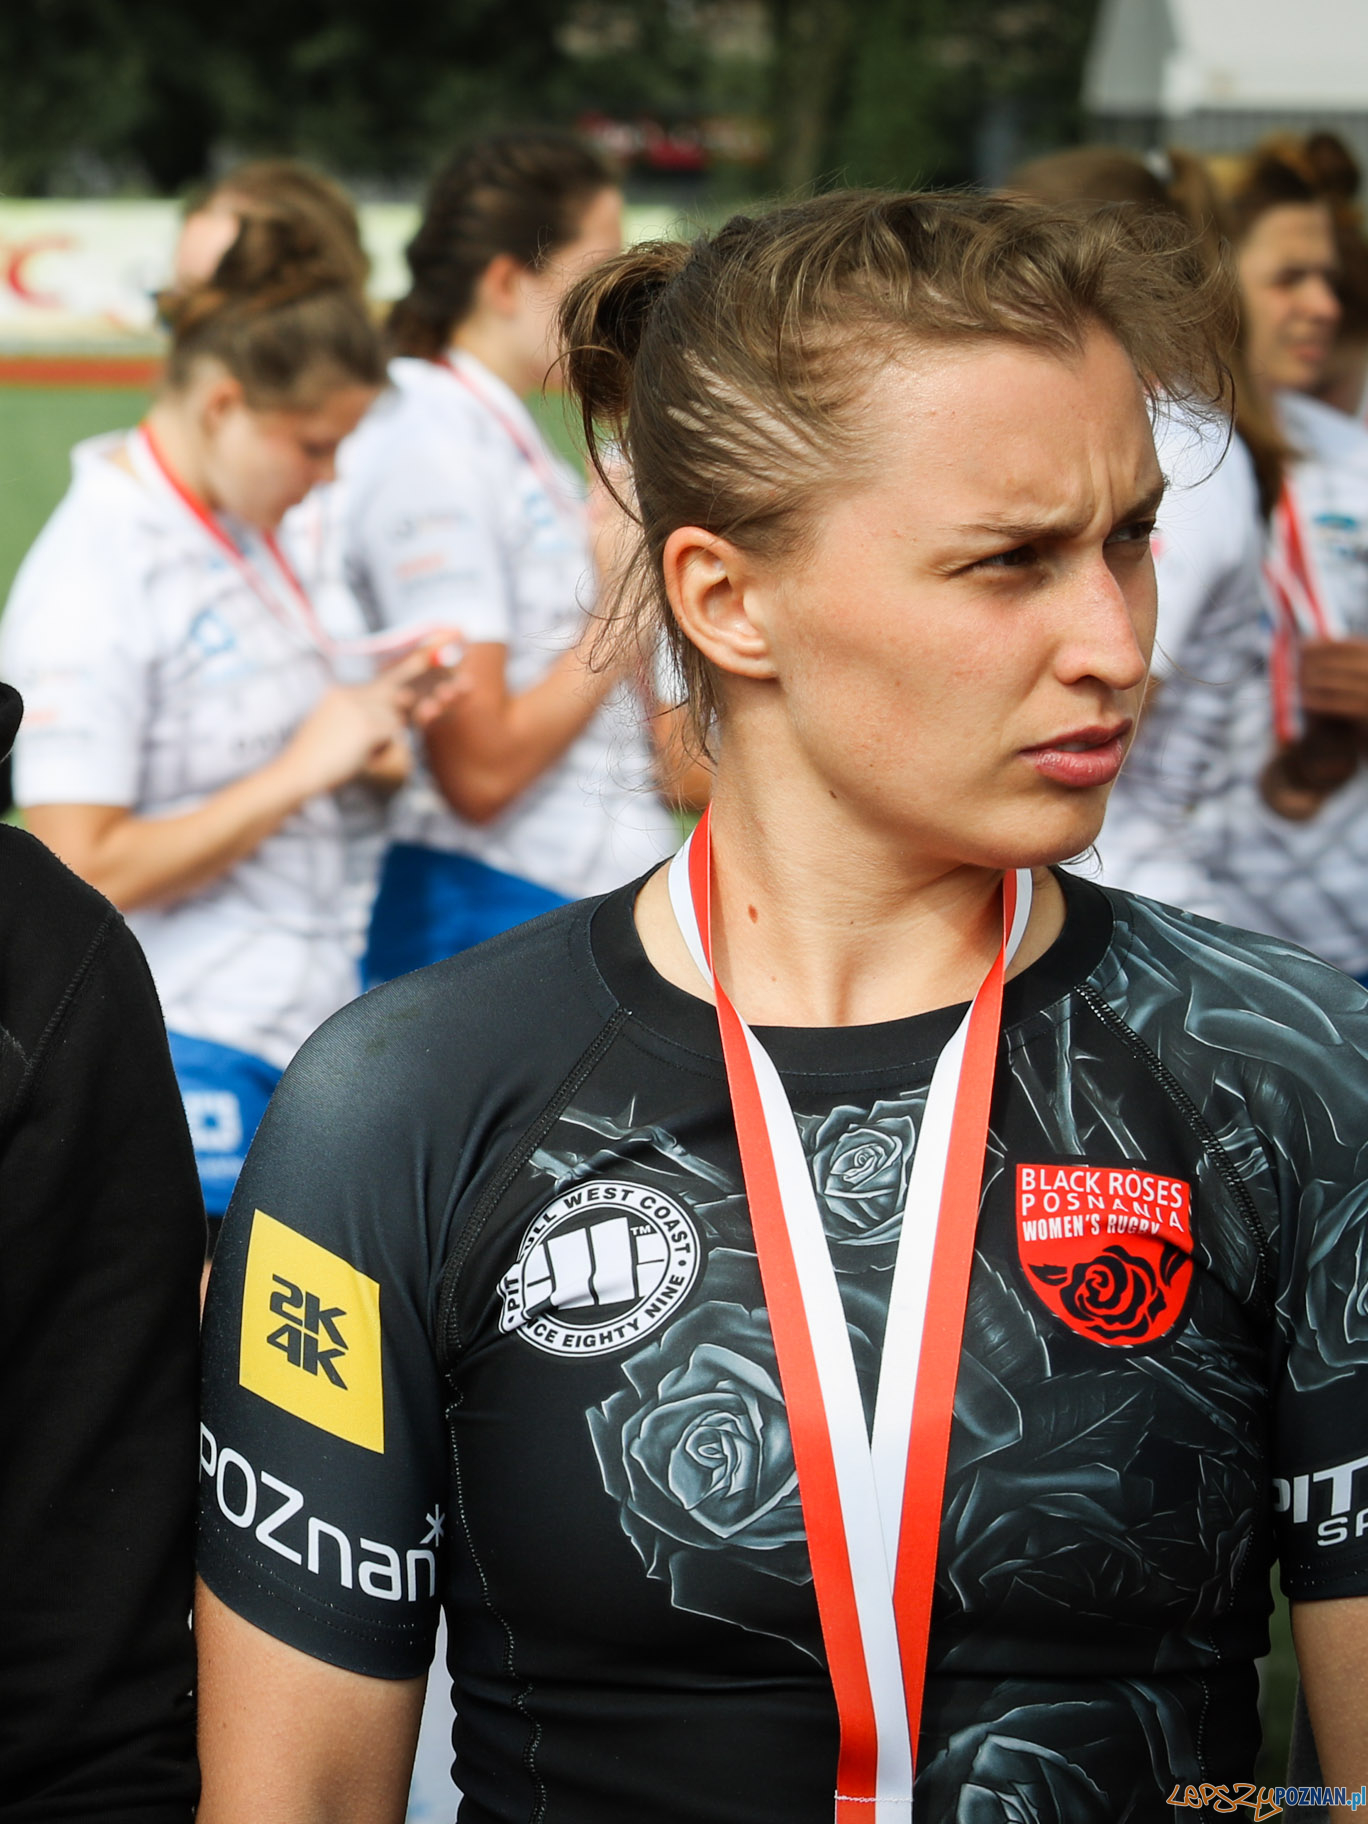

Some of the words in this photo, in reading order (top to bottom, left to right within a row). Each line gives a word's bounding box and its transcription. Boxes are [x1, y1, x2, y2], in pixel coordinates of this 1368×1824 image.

[1021, 1168, 1101, 1194] BLACK
[1108, 1172, 1183, 1208] ROSES
[1021, 1192, 1184, 1233] POSNANIA
[504, 1276, 521, 1312] PIT
[563, 1187, 634, 1209] WEST
[639, 1195, 690, 1254] COAST
[1022, 1213, 1100, 1242] WOMEN'S
[269, 1273, 349, 1350] 2K
[562, 1319, 640, 1348] EIGHTY
[644, 1274, 685, 1319] NINE
[266, 1323, 349, 1391] 4K
